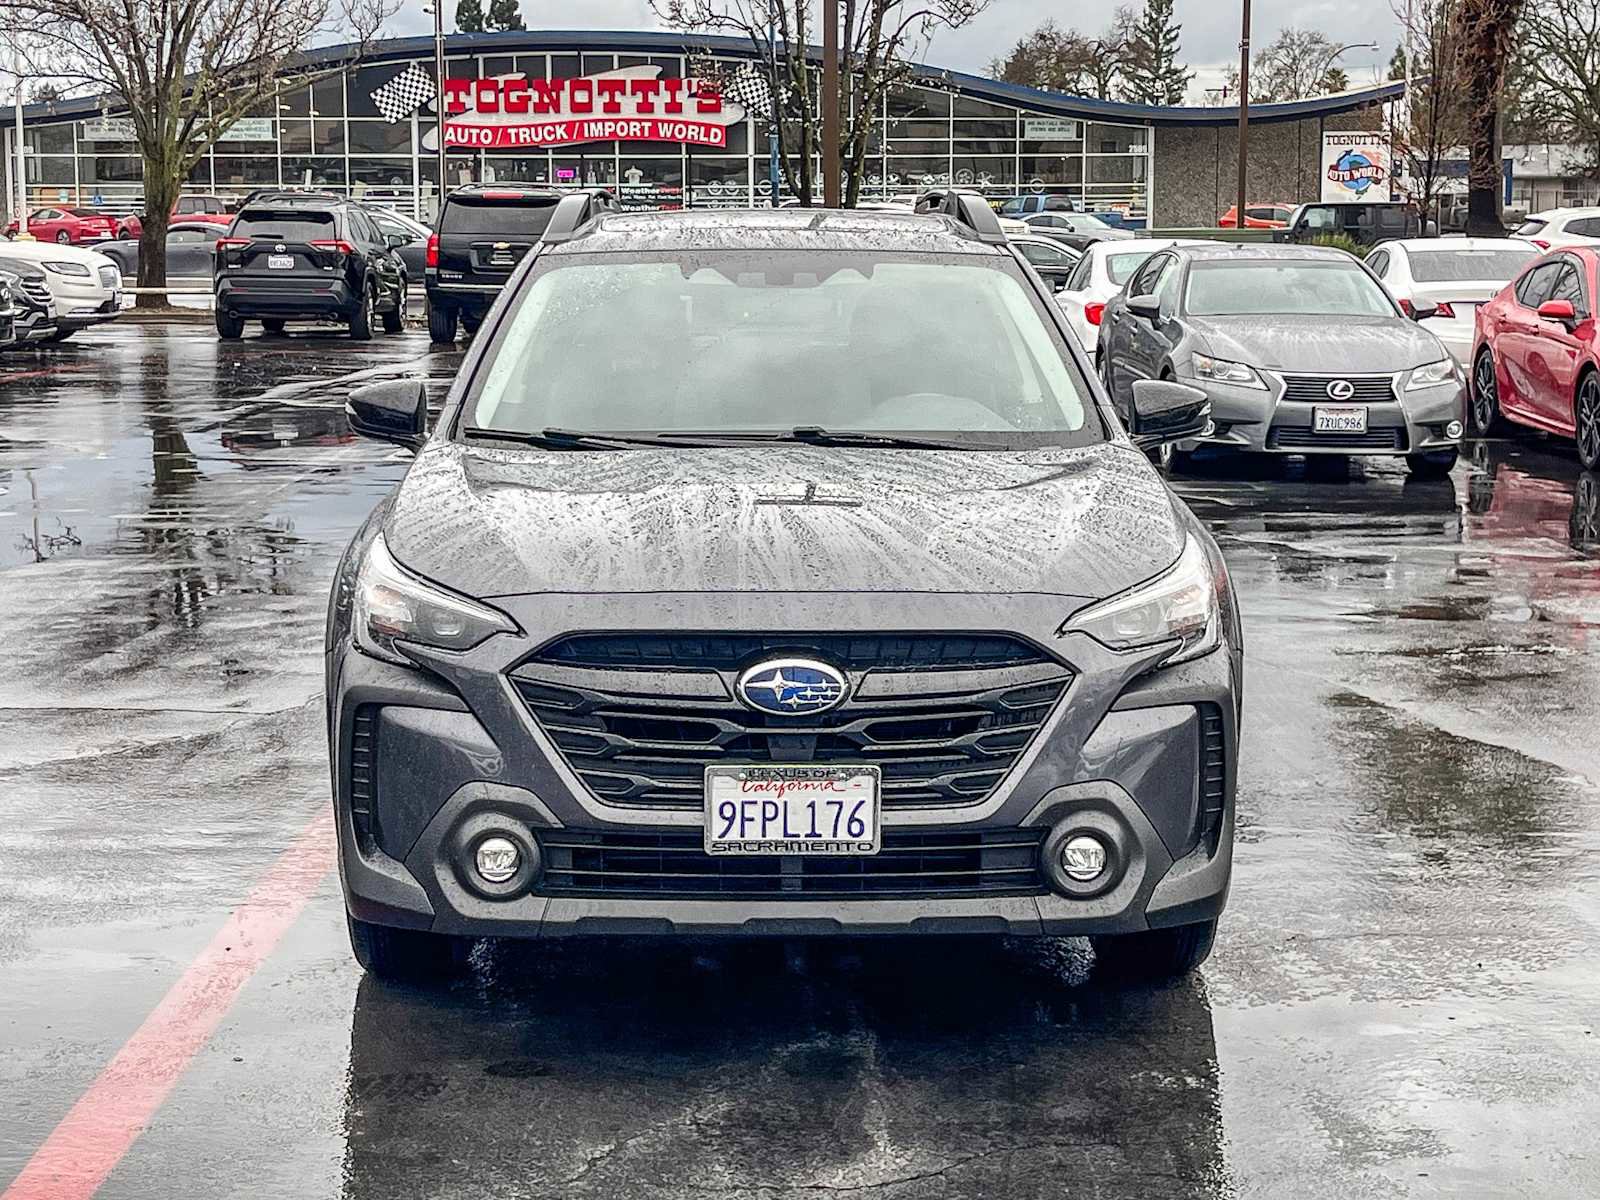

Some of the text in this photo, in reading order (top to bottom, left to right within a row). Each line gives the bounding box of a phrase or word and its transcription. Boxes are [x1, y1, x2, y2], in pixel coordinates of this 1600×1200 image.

[444, 79, 721, 113] TOGNOTTI'S
[445, 127, 492, 144] AUTO
[507, 124, 568, 143] TRUCK
[583, 121, 652, 137] IMPORT
[658, 122, 722, 143] WORLD
[1328, 165, 1384, 182] AUTO WORLD
[1319, 417, 1362, 429] 7XUC986
[741, 780, 846, 799] California
[718, 800, 866, 838] 9FPL176
[711, 842, 874, 852] SACRAMENTO
